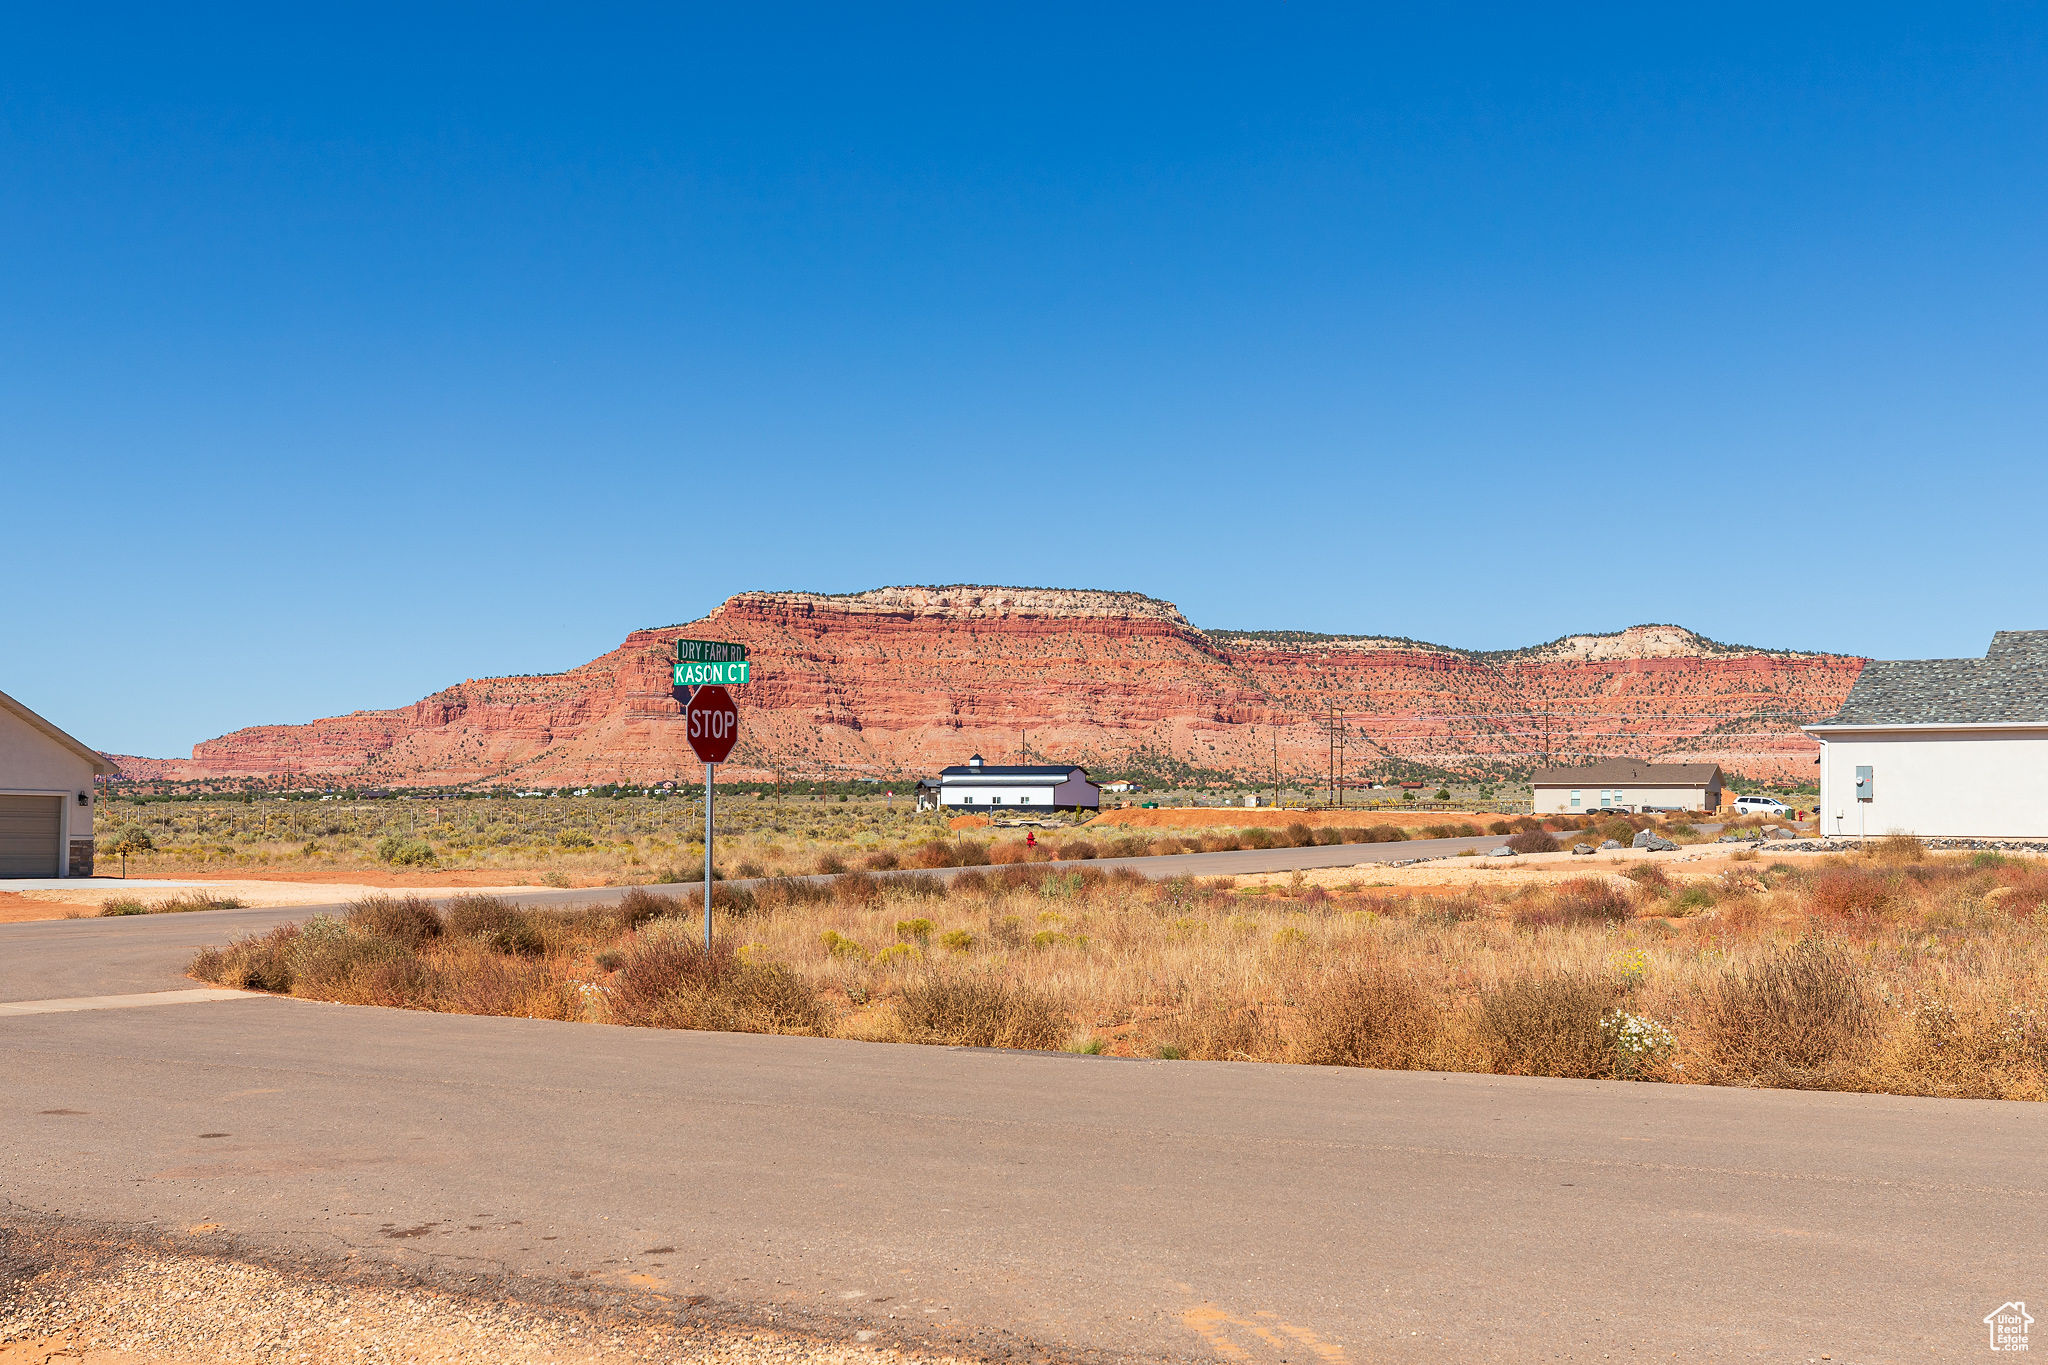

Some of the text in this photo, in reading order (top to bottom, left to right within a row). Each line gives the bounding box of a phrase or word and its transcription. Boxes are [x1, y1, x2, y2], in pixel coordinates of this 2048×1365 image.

[682, 641, 742, 662] DRY FARM RD
[675, 663, 747, 683] KASON CT
[690, 709, 735, 739] STOP
